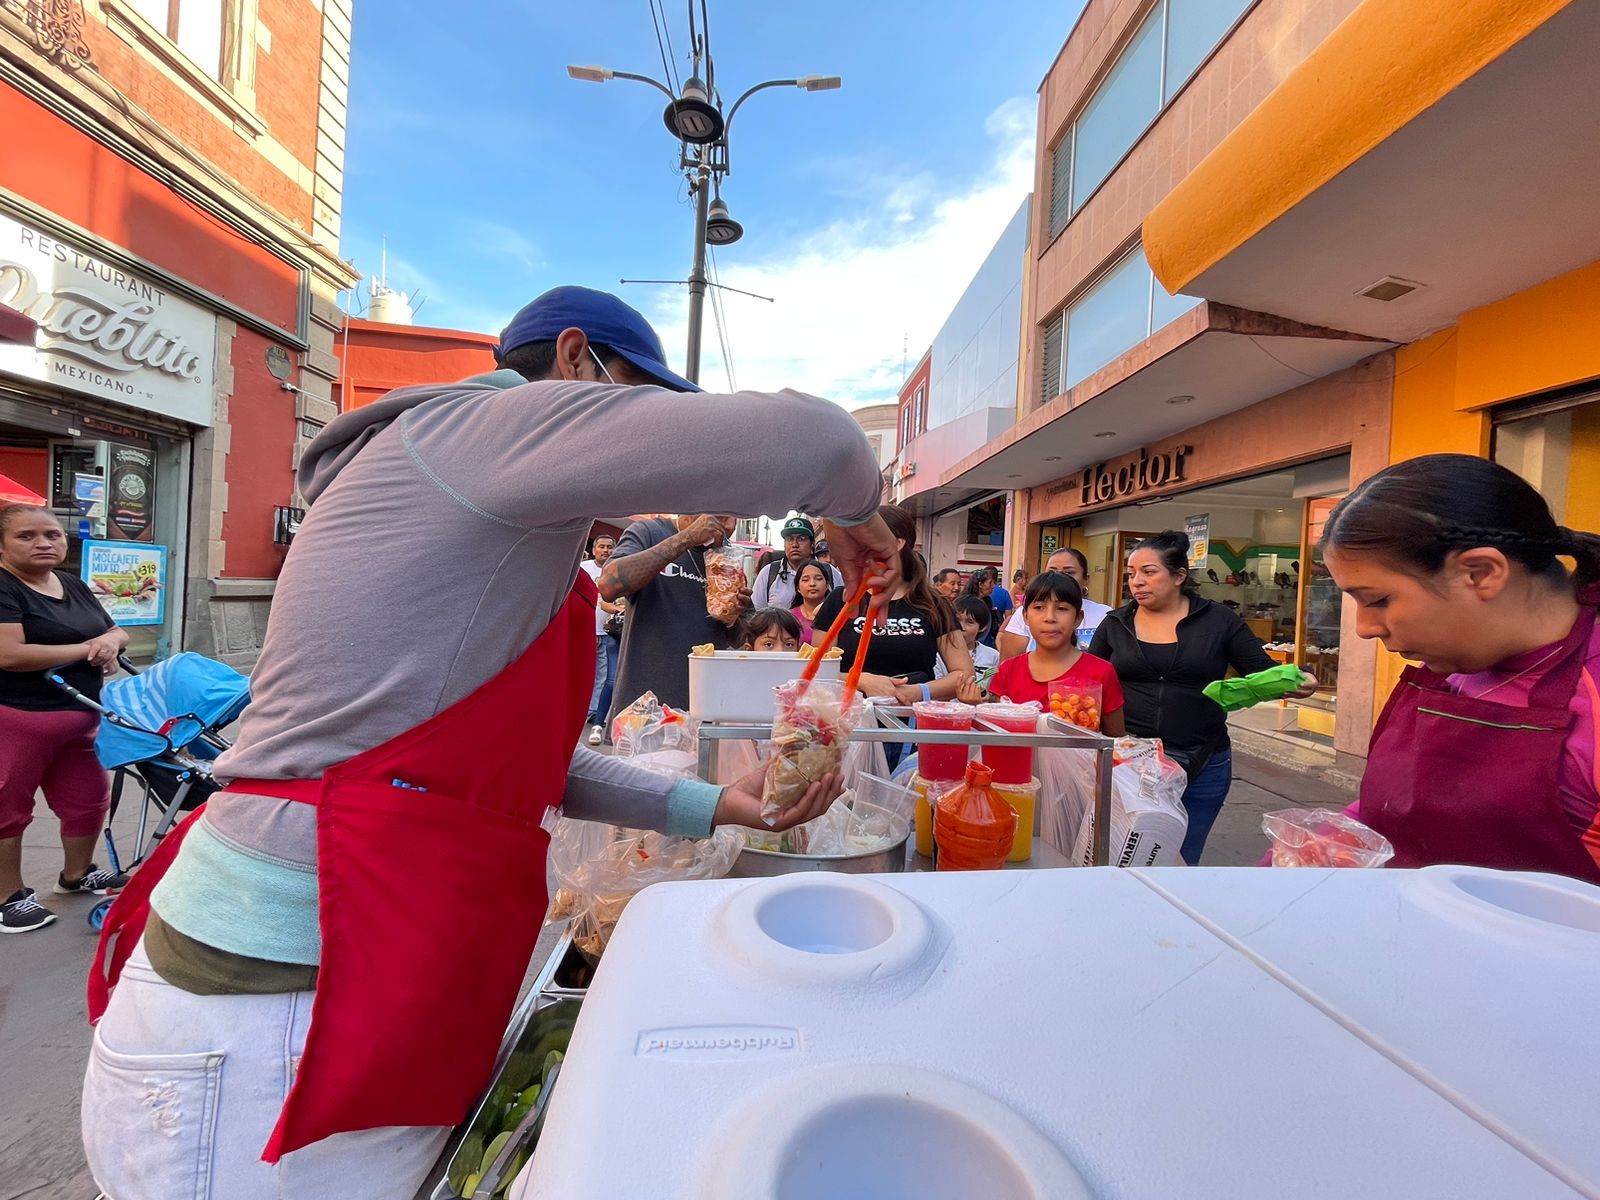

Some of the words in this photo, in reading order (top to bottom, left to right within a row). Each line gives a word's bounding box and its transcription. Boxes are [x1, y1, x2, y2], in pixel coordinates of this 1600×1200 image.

[20, 226, 166, 306] RESTAURANT
[55, 361, 134, 395] MEXICANO
[1078, 444, 1192, 507] Hector
[92, 552, 140, 565] MOLCAJETE
[92, 562, 119, 574] MIXTO
[646, 1035, 794, 1053] Rubbermaid
